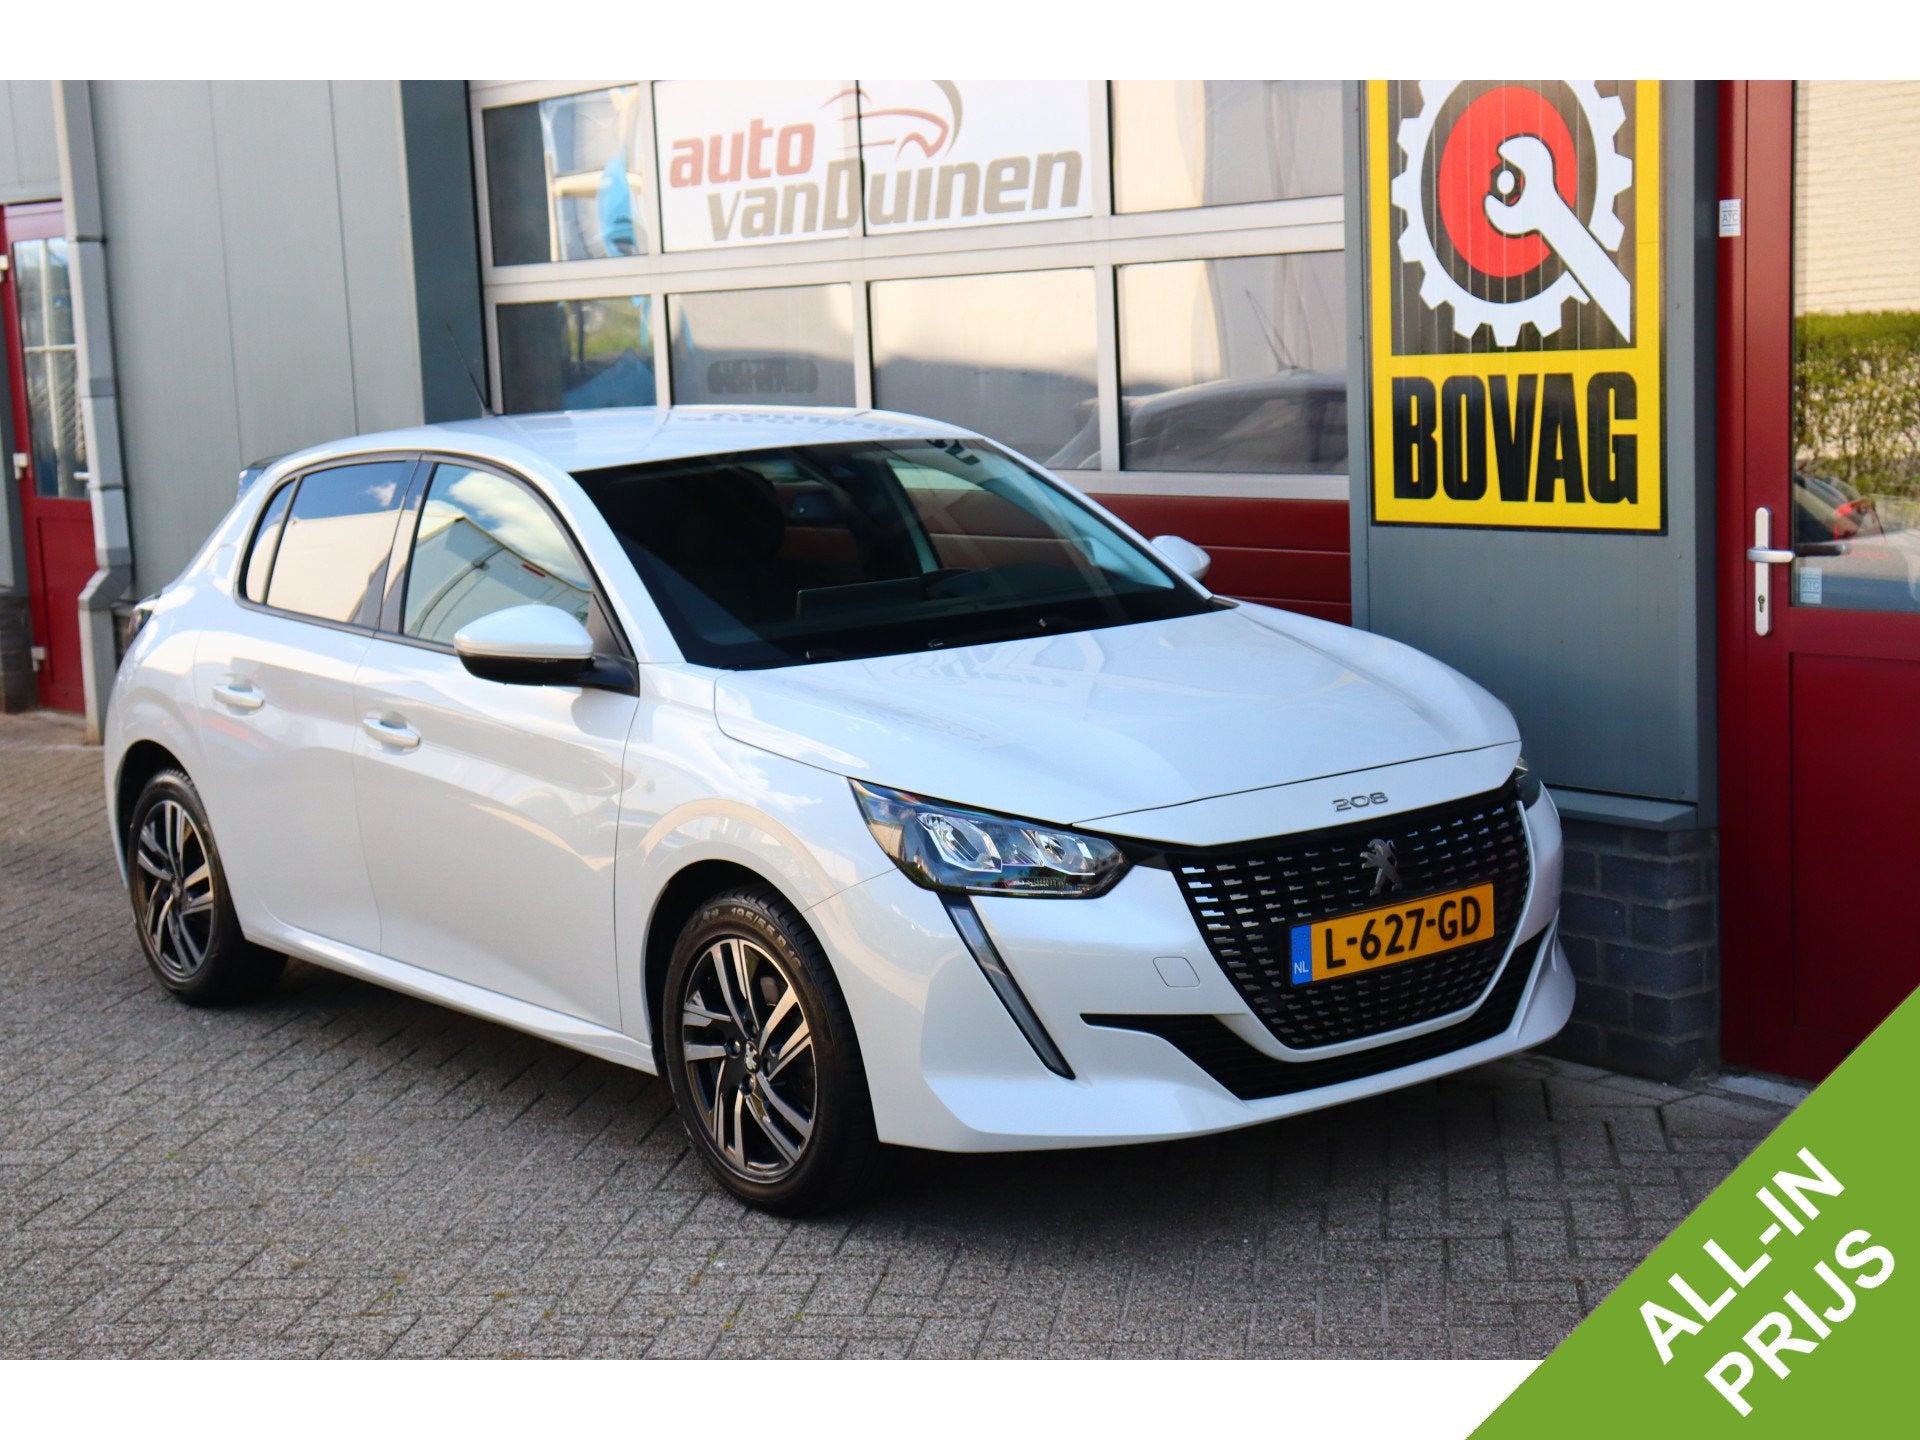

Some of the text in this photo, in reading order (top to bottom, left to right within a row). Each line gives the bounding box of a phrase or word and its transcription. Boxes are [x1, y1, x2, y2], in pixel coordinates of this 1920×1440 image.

[669, 118, 816, 188] auto
[1391, 371, 1639, 505] BOVAG
[1332, 792, 1388, 812] 208
[1294, 961, 1309, 974] NL
[1325, 896, 1481, 970] L-627-GD
